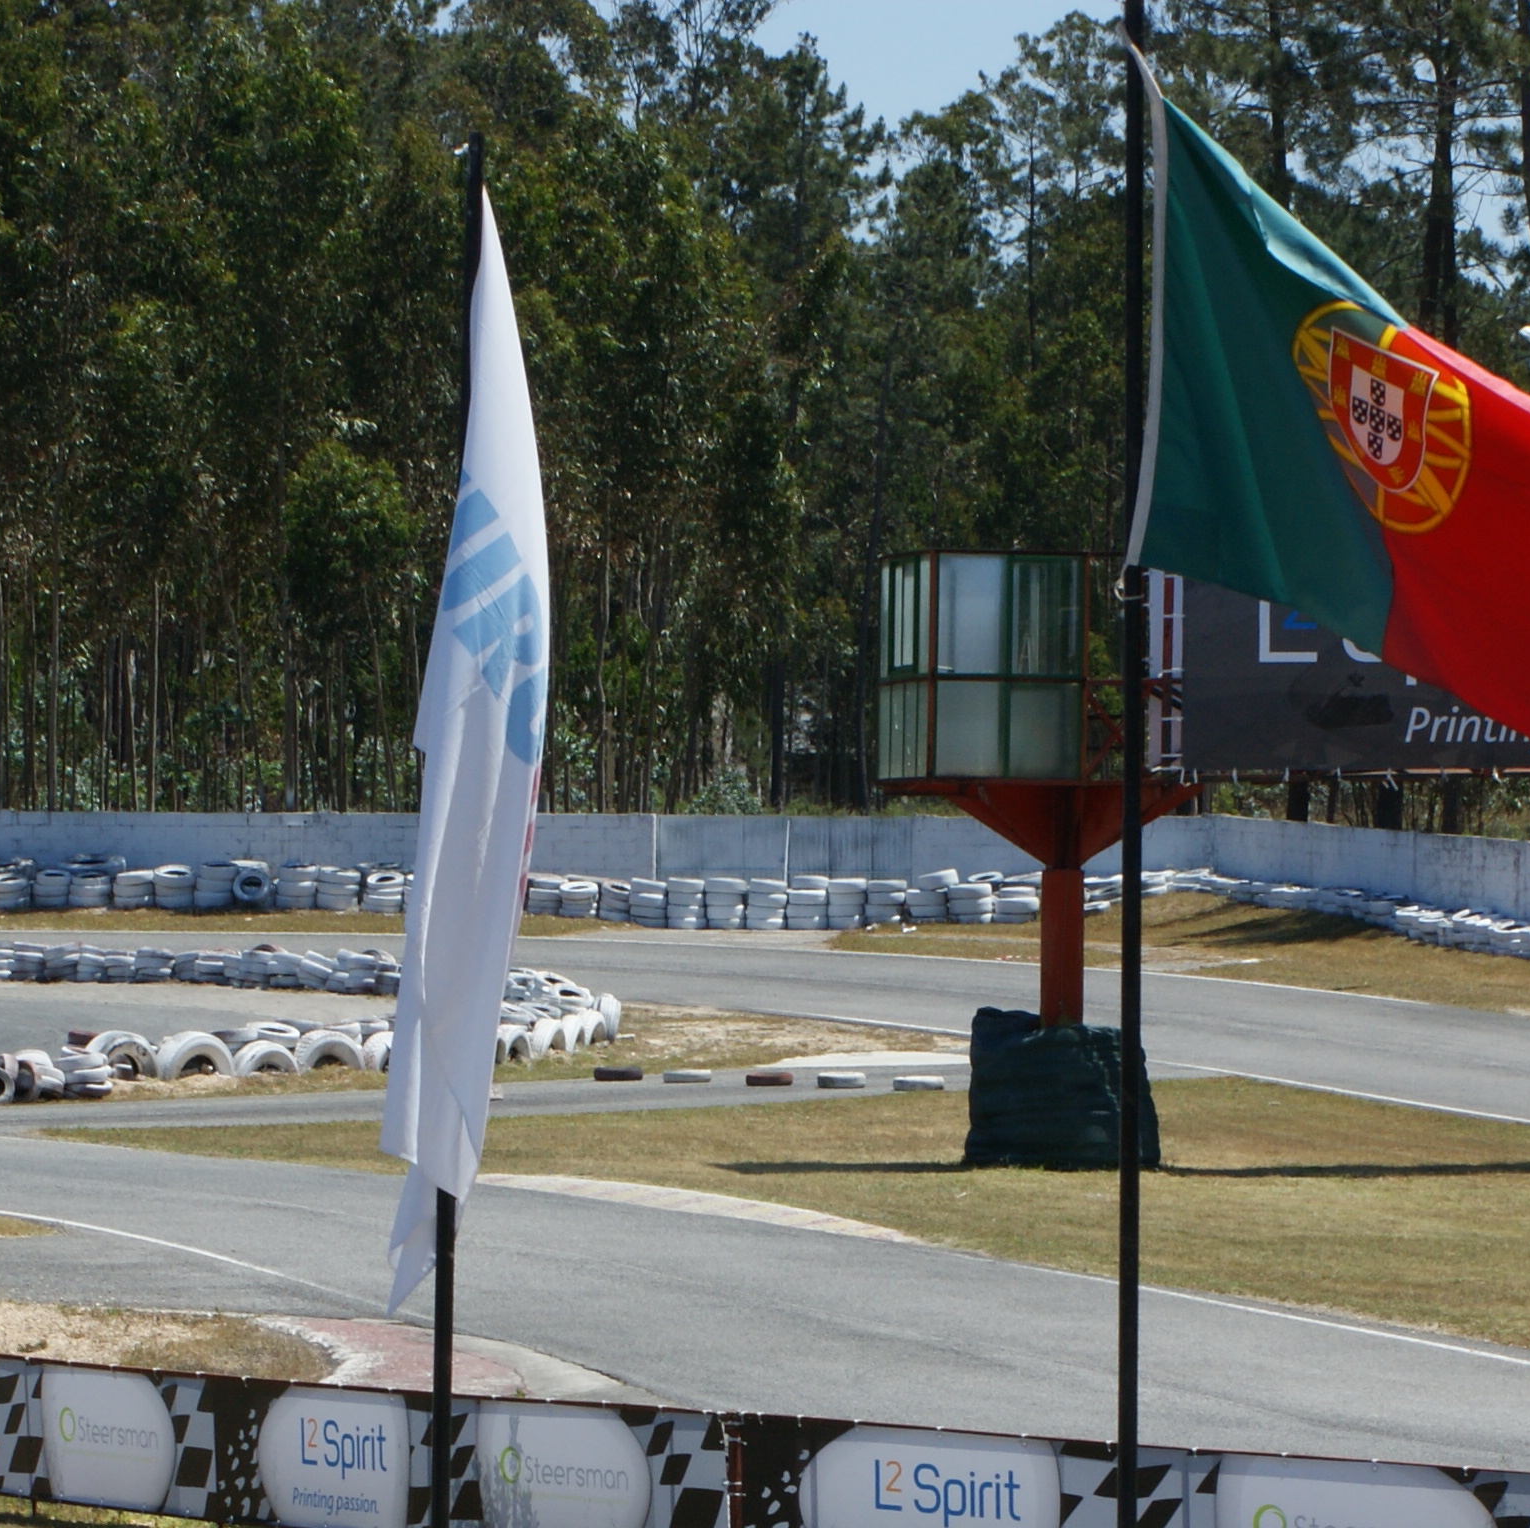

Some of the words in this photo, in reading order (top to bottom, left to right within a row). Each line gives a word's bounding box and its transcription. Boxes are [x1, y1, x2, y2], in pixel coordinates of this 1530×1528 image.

[77, 1415, 159, 1450] Steersman
[323, 1419, 387, 1480] Spirit
[524, 1455, 630, 1492] Steersman
[291, 1486, 333, 1517] Printing
[913, 1463, 1021, 1528] Spirit
